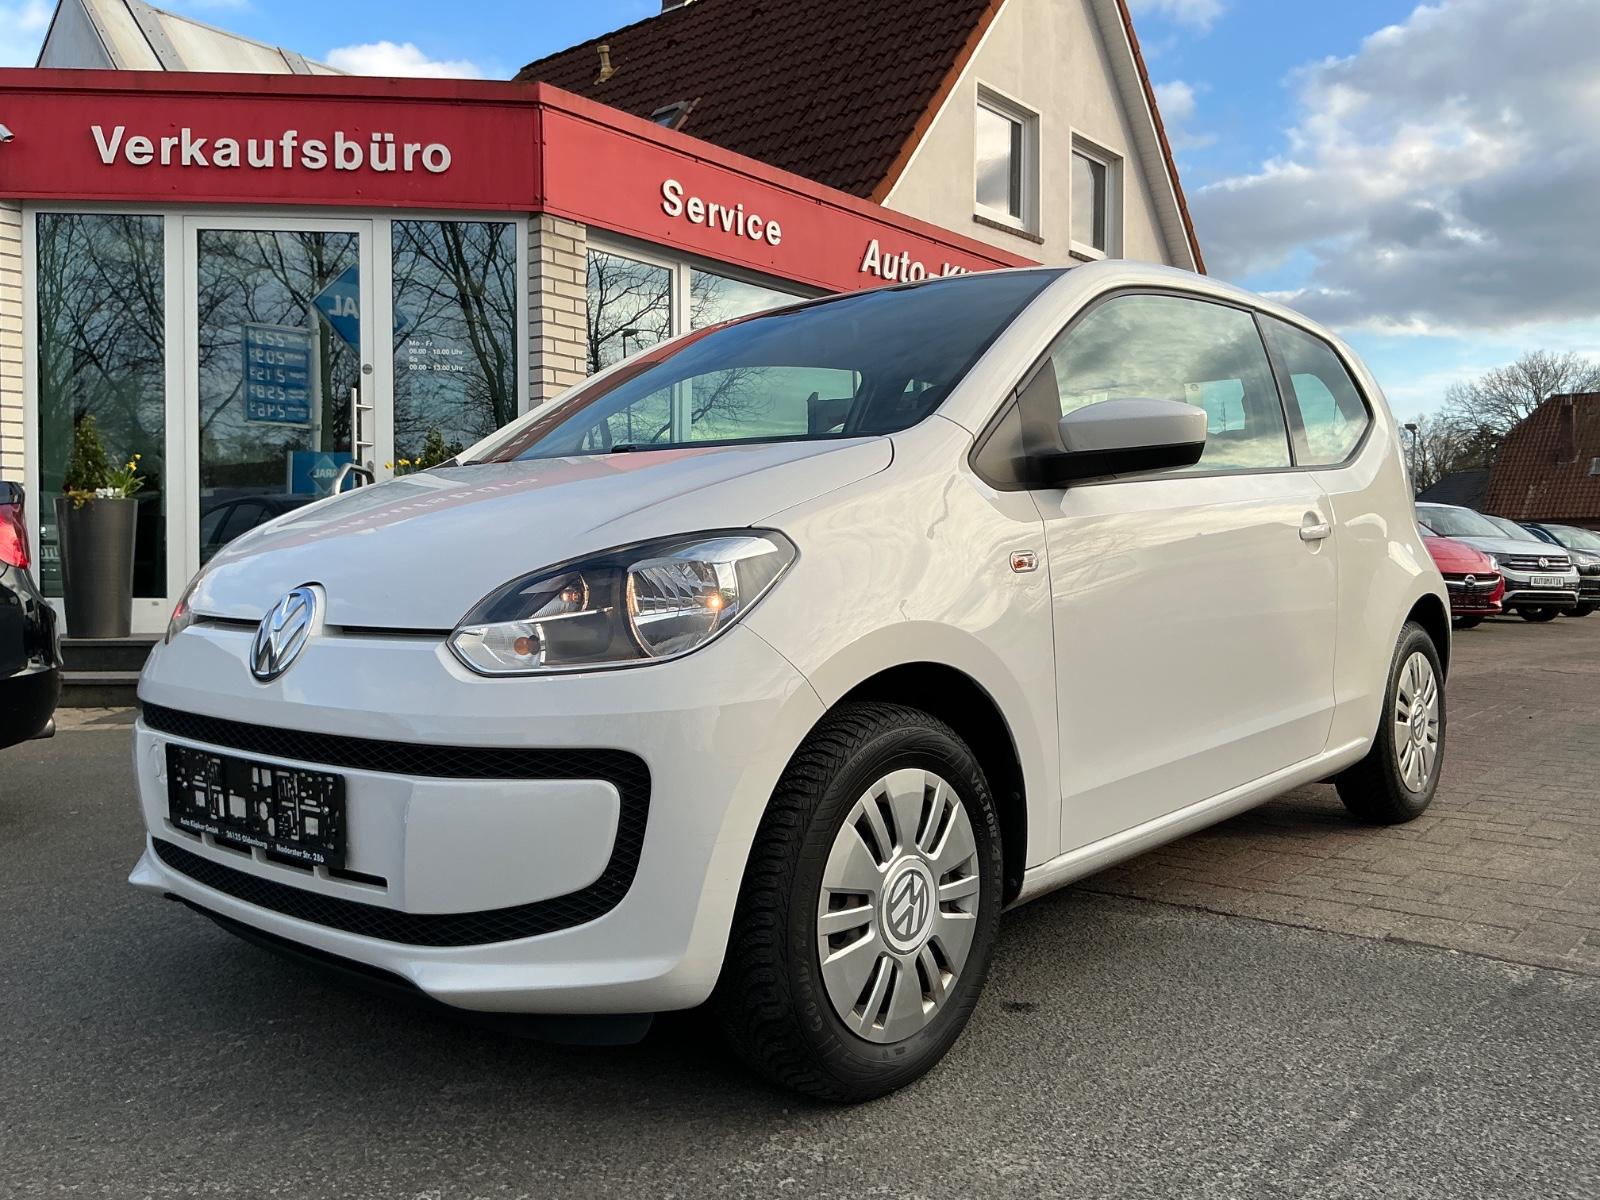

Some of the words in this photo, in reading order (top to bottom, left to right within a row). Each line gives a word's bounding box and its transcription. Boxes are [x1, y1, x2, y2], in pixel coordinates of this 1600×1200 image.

[90, 125, 452, 174] Verkaufsbüro
[661, 179, 782, 246] Service
[1533, 577, 1562, 586] AUTOMATIK
